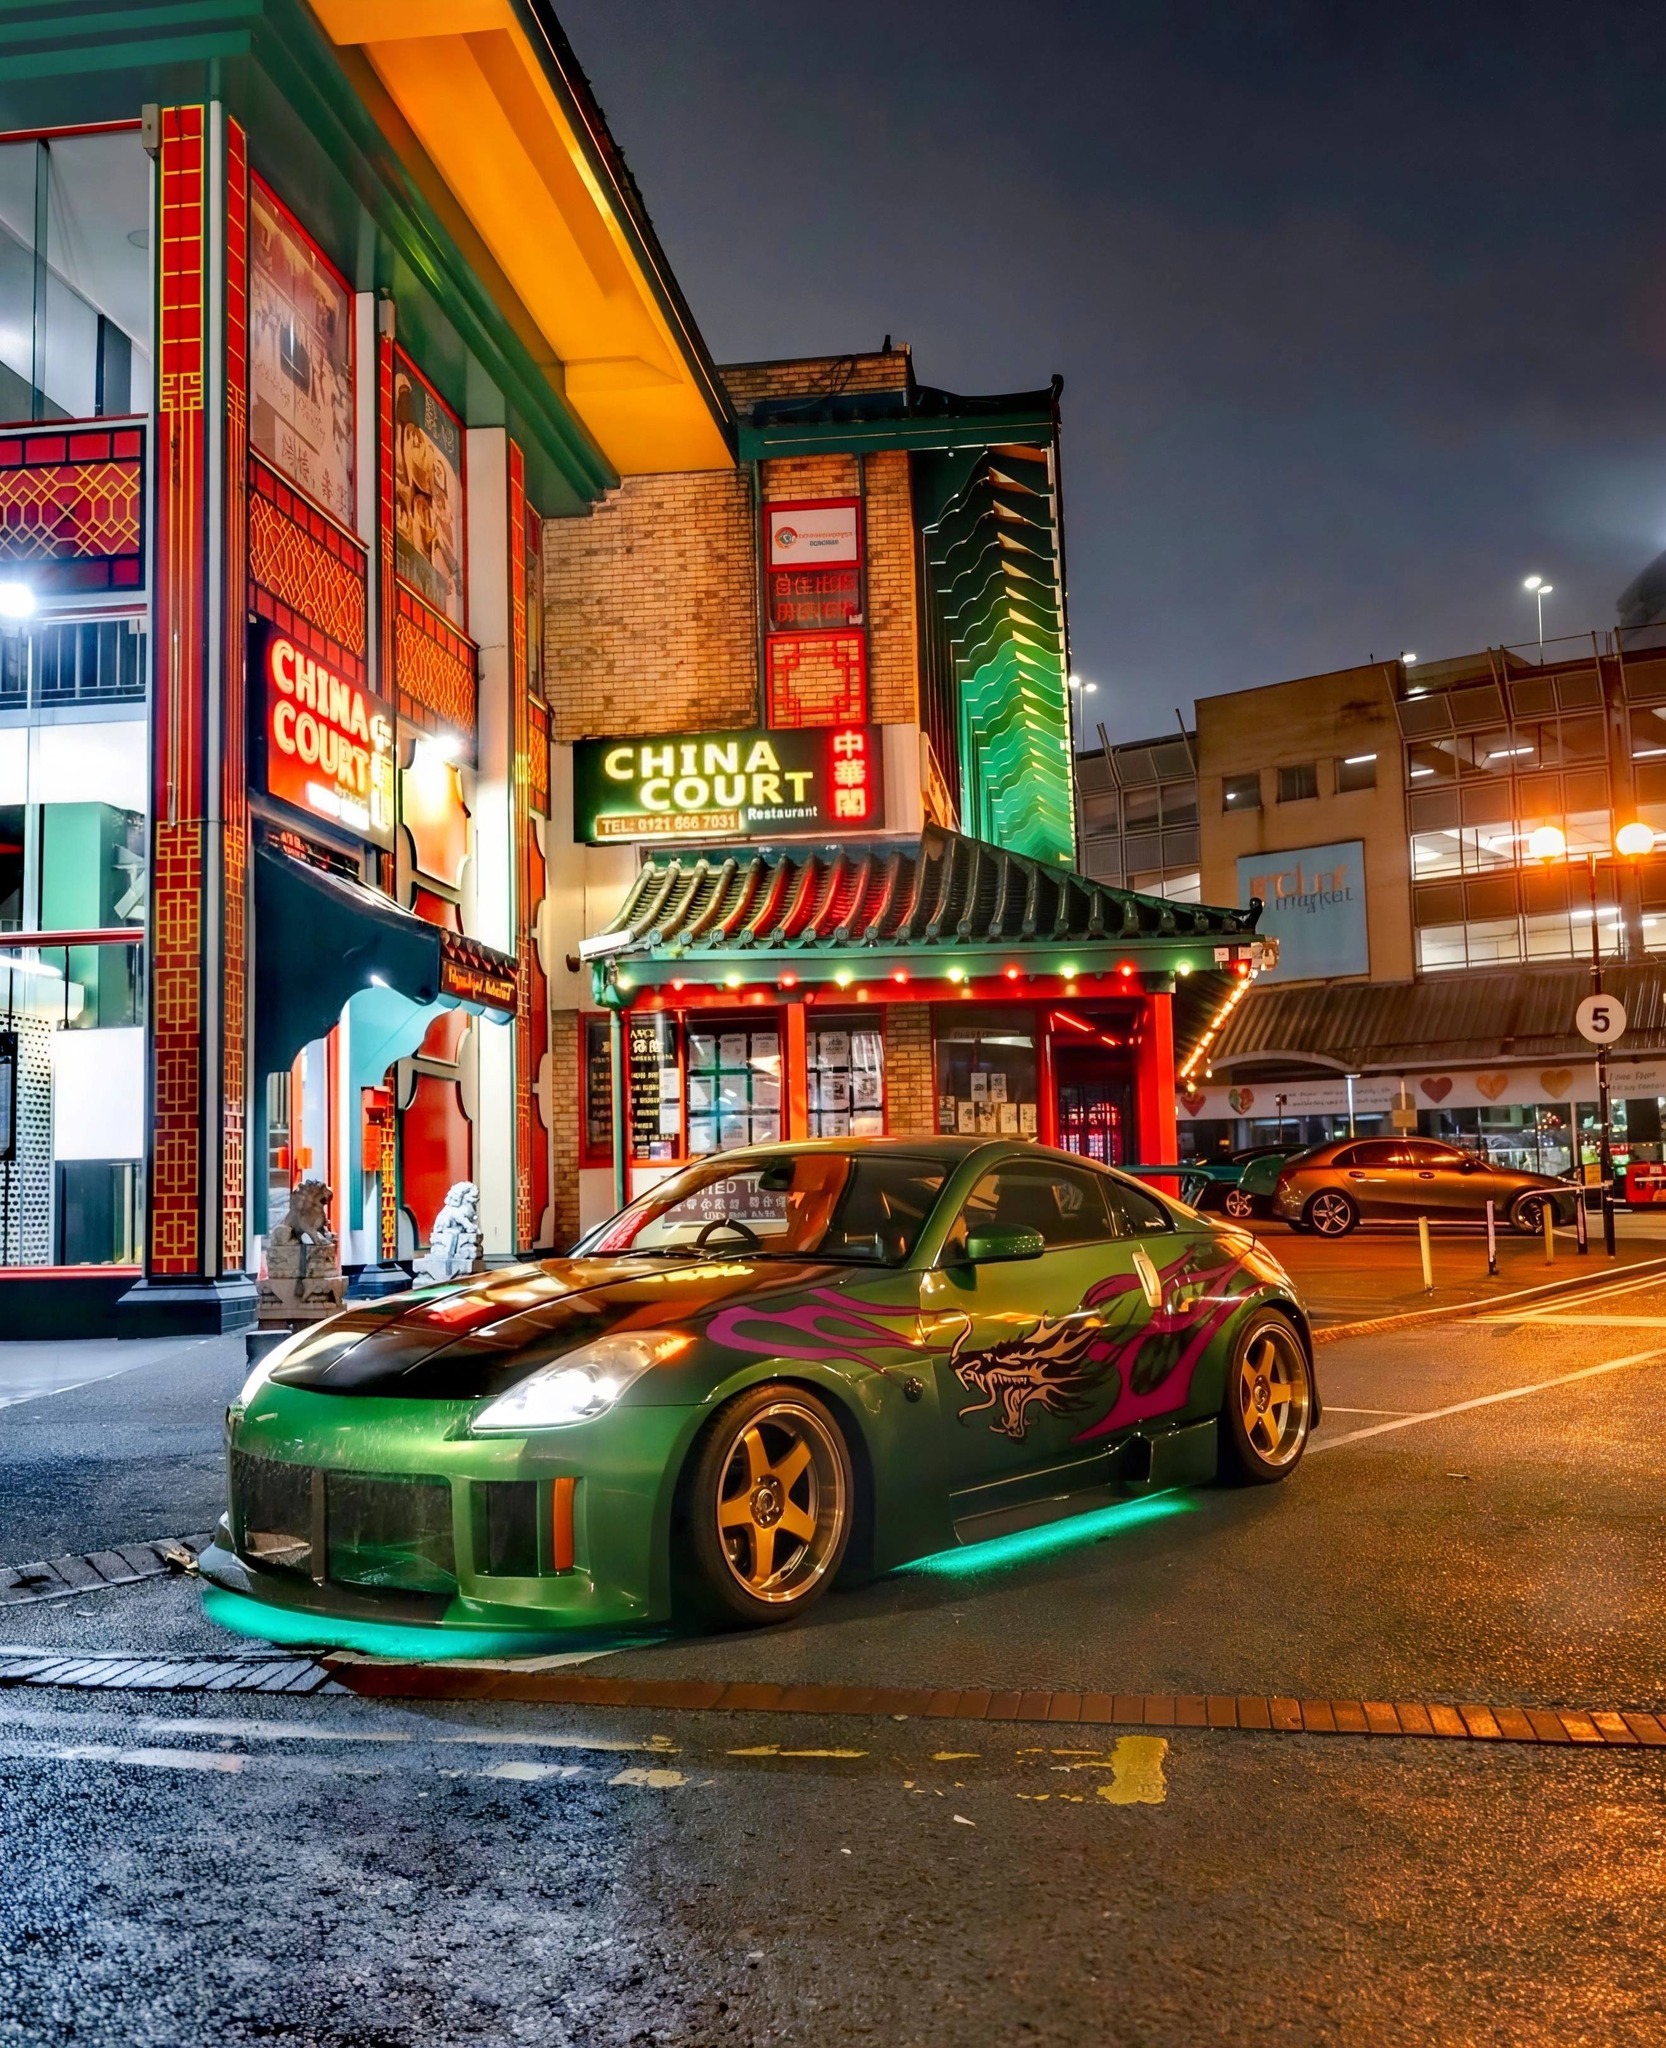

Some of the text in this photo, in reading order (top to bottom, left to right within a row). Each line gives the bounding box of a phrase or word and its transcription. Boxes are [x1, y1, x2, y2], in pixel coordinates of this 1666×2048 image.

[272, 638, 369, 743] CHINA
[273, 699, 369, 794] COURT
[604, 740, 780, 780] CHINA
[640, 771, 813, 810] COURT
[602, 820, 634, 833] TEL:
[638, 817, 670, 832] 0121
[702, 814, 735, 829] 7031
[747, 806, 818, 820] Restaurant
[1592, 1007, 1610, 1033] 5
